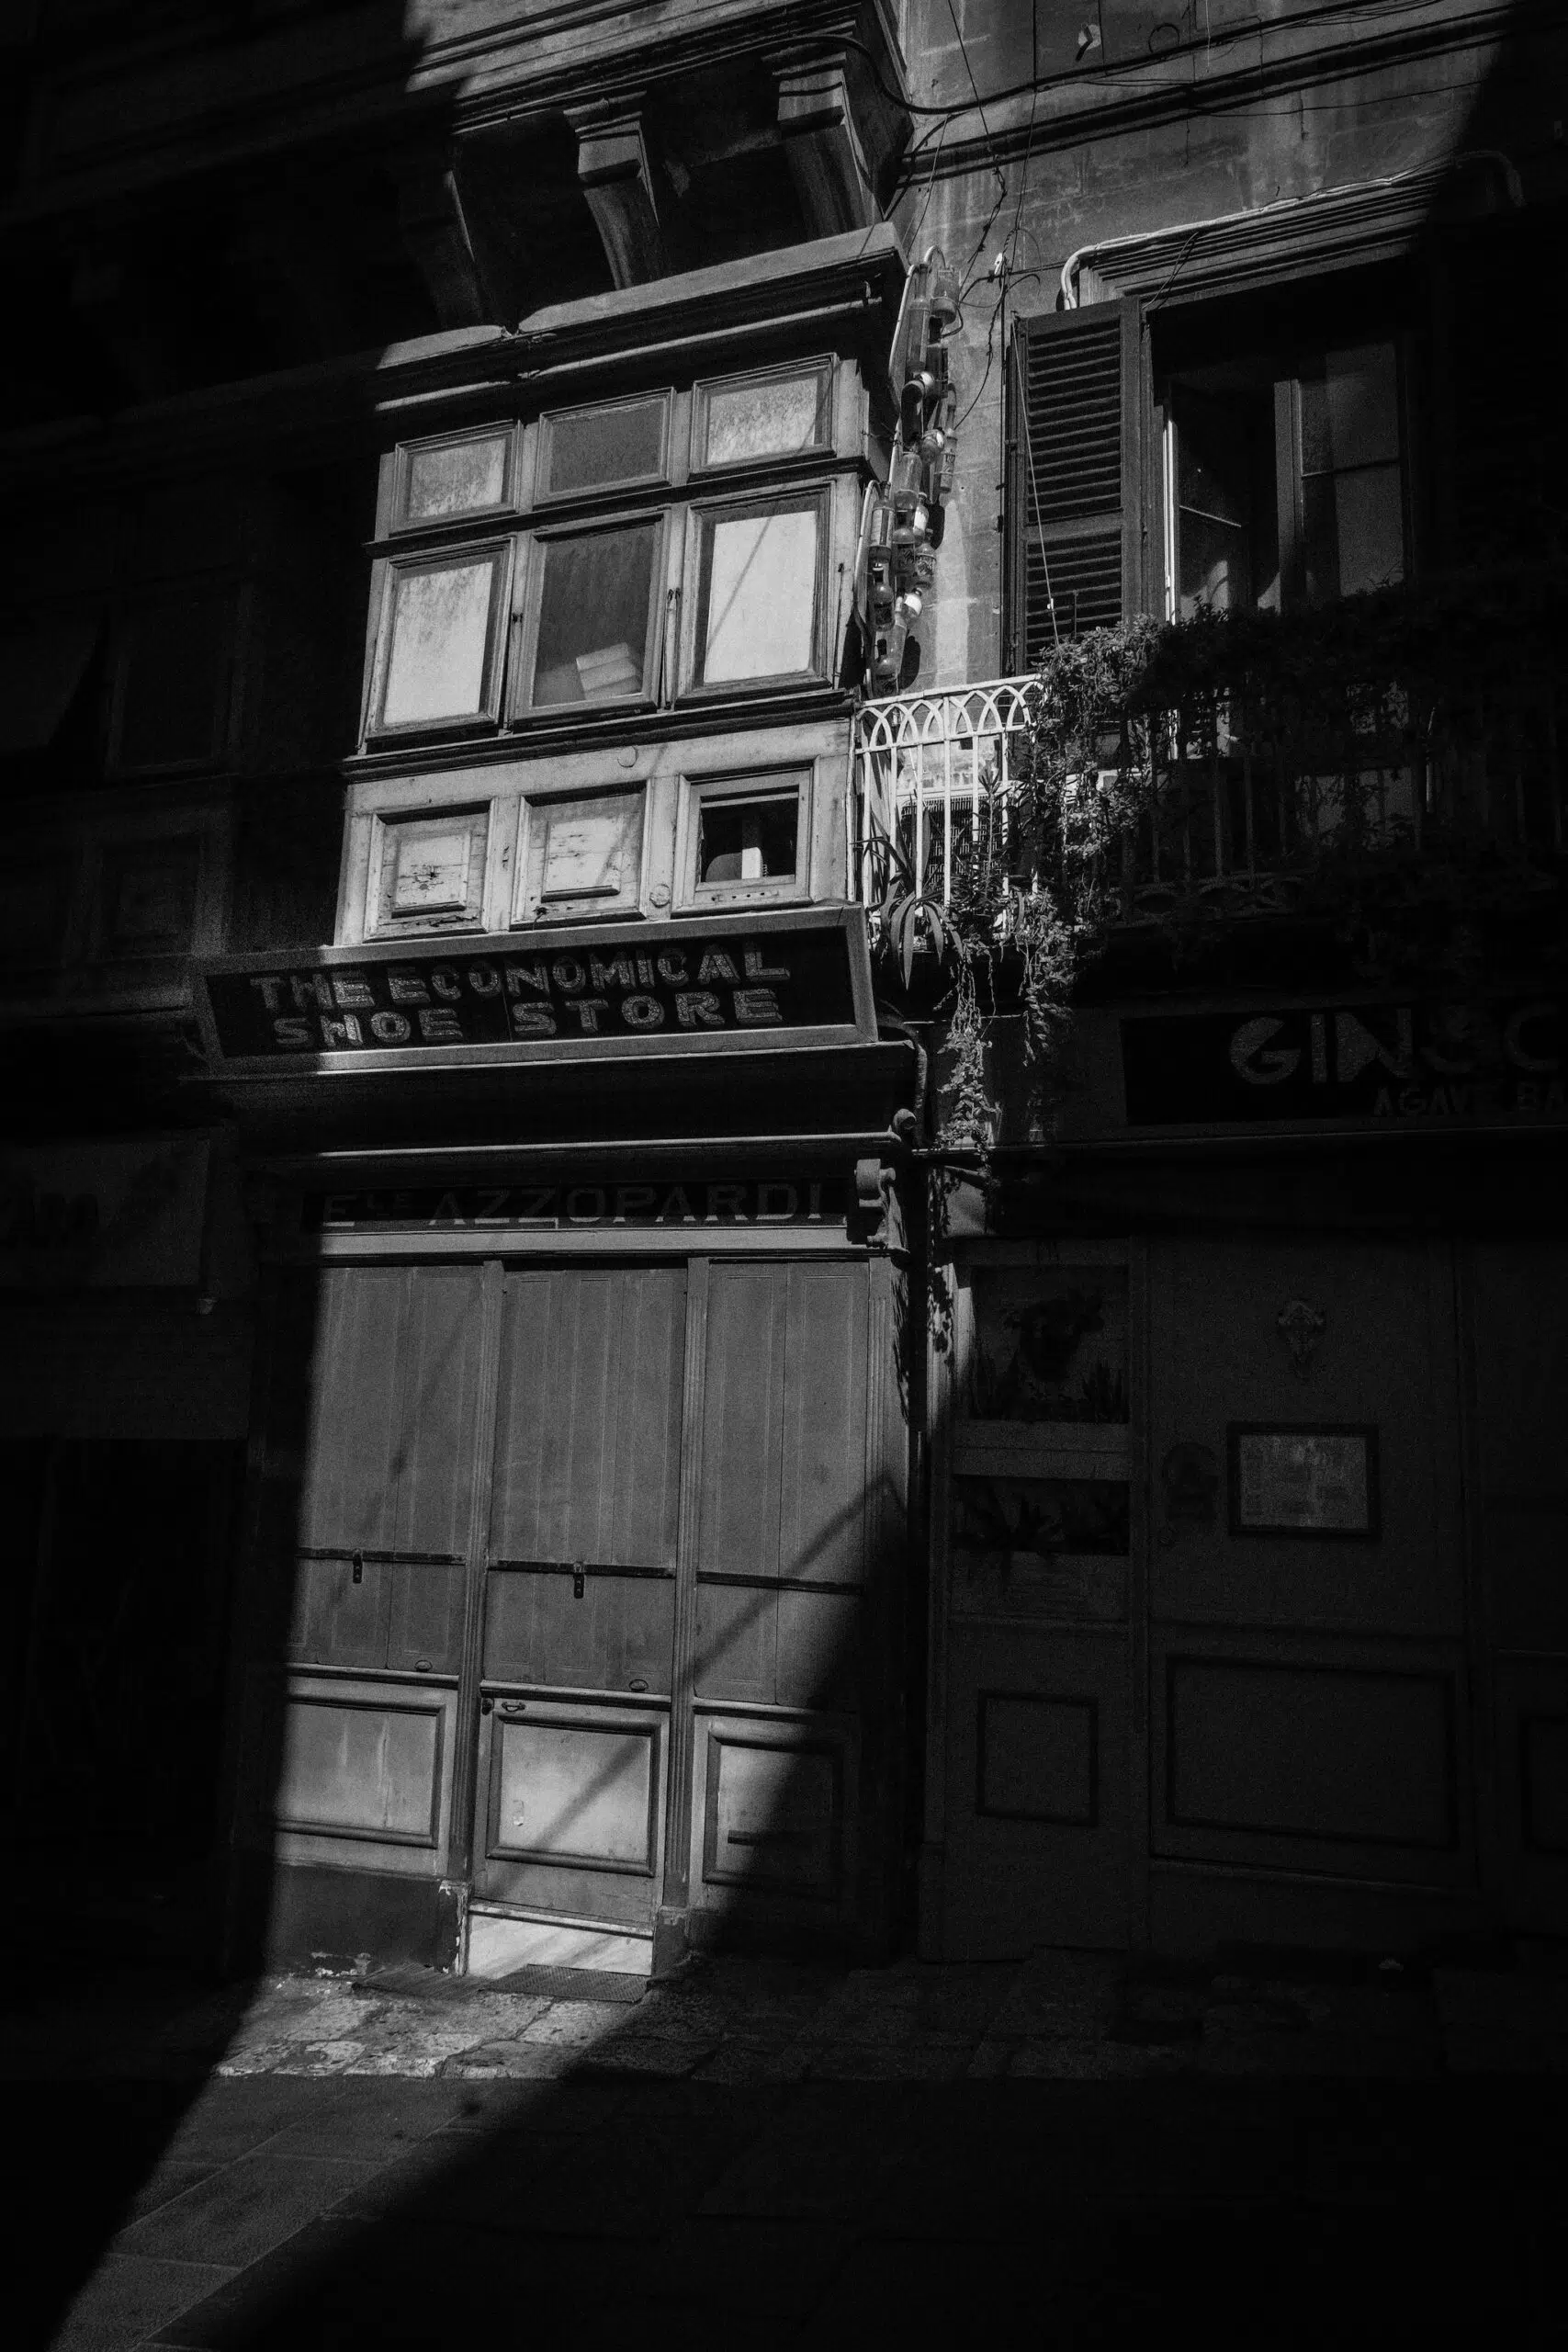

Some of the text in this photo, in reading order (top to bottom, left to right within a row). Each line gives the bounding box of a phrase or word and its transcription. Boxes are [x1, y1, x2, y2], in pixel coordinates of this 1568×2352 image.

[250, 939, 792, 1011] THE ECONOMICAL
[272, 987, 788, 1049] SHOE STORE
[429, 1182, 822, 1227] AZZOPARDI
